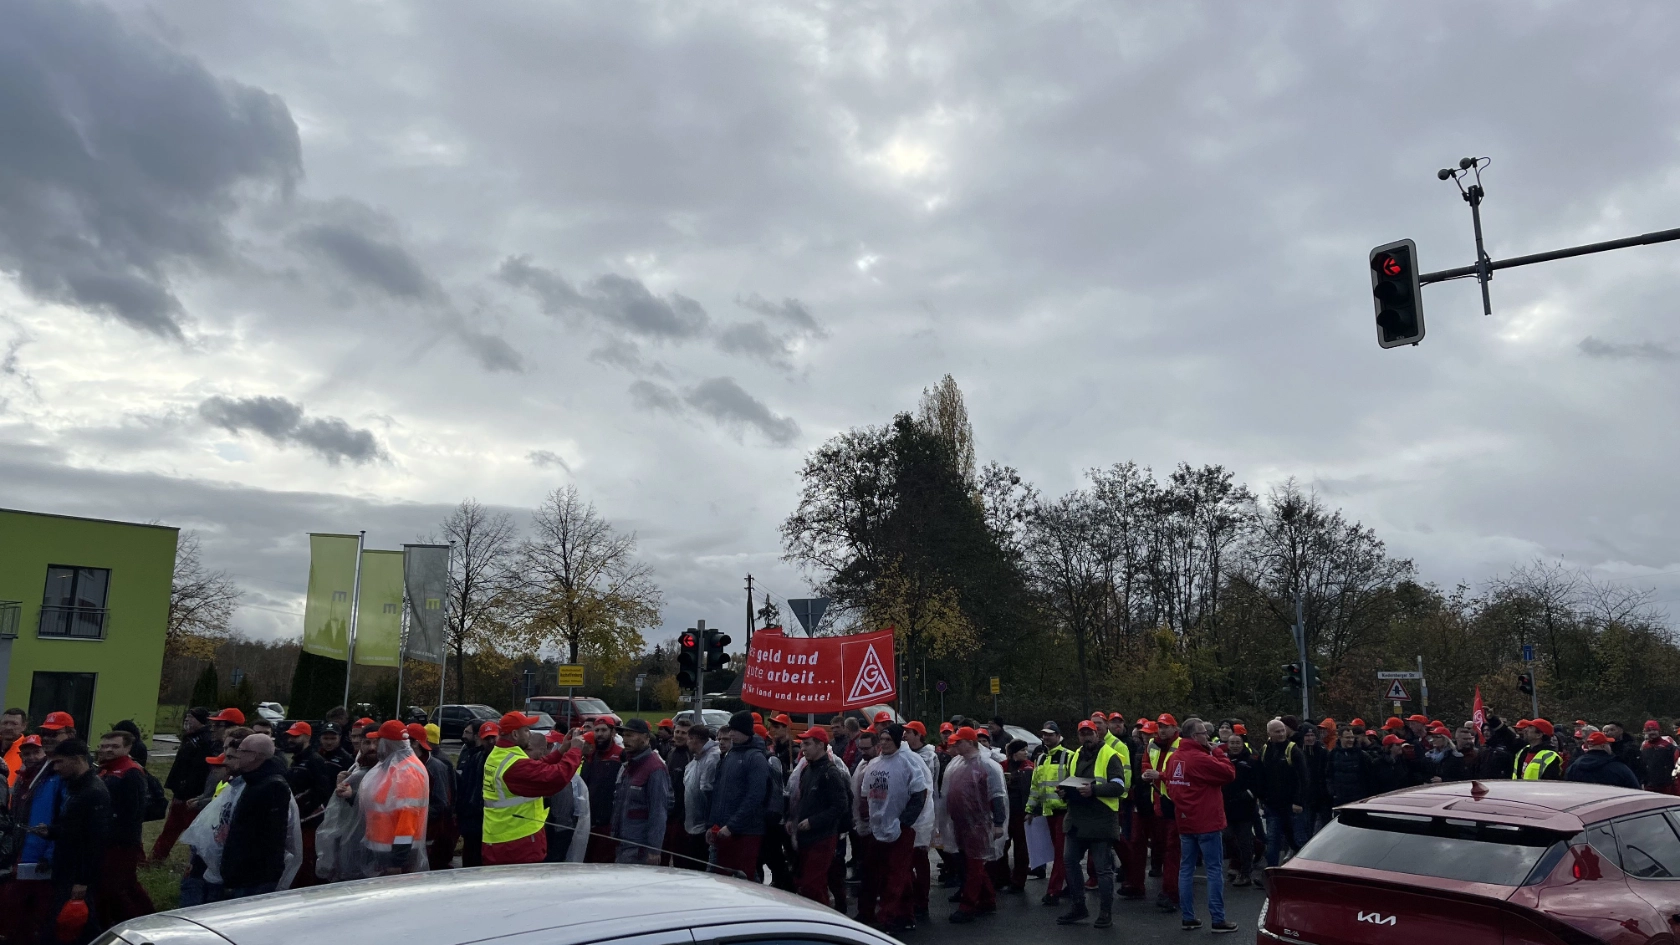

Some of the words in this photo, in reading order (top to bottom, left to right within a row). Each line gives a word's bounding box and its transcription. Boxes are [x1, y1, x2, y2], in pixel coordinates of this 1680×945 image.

[757, 649, 781, 662] geld
[787, 651, 818, 665] und
[746, 665, 763, 678] gute
[756, 687, 772, 697] land
[775, 692, 792, 700] und
[796, 692, 830, 701] leute!
